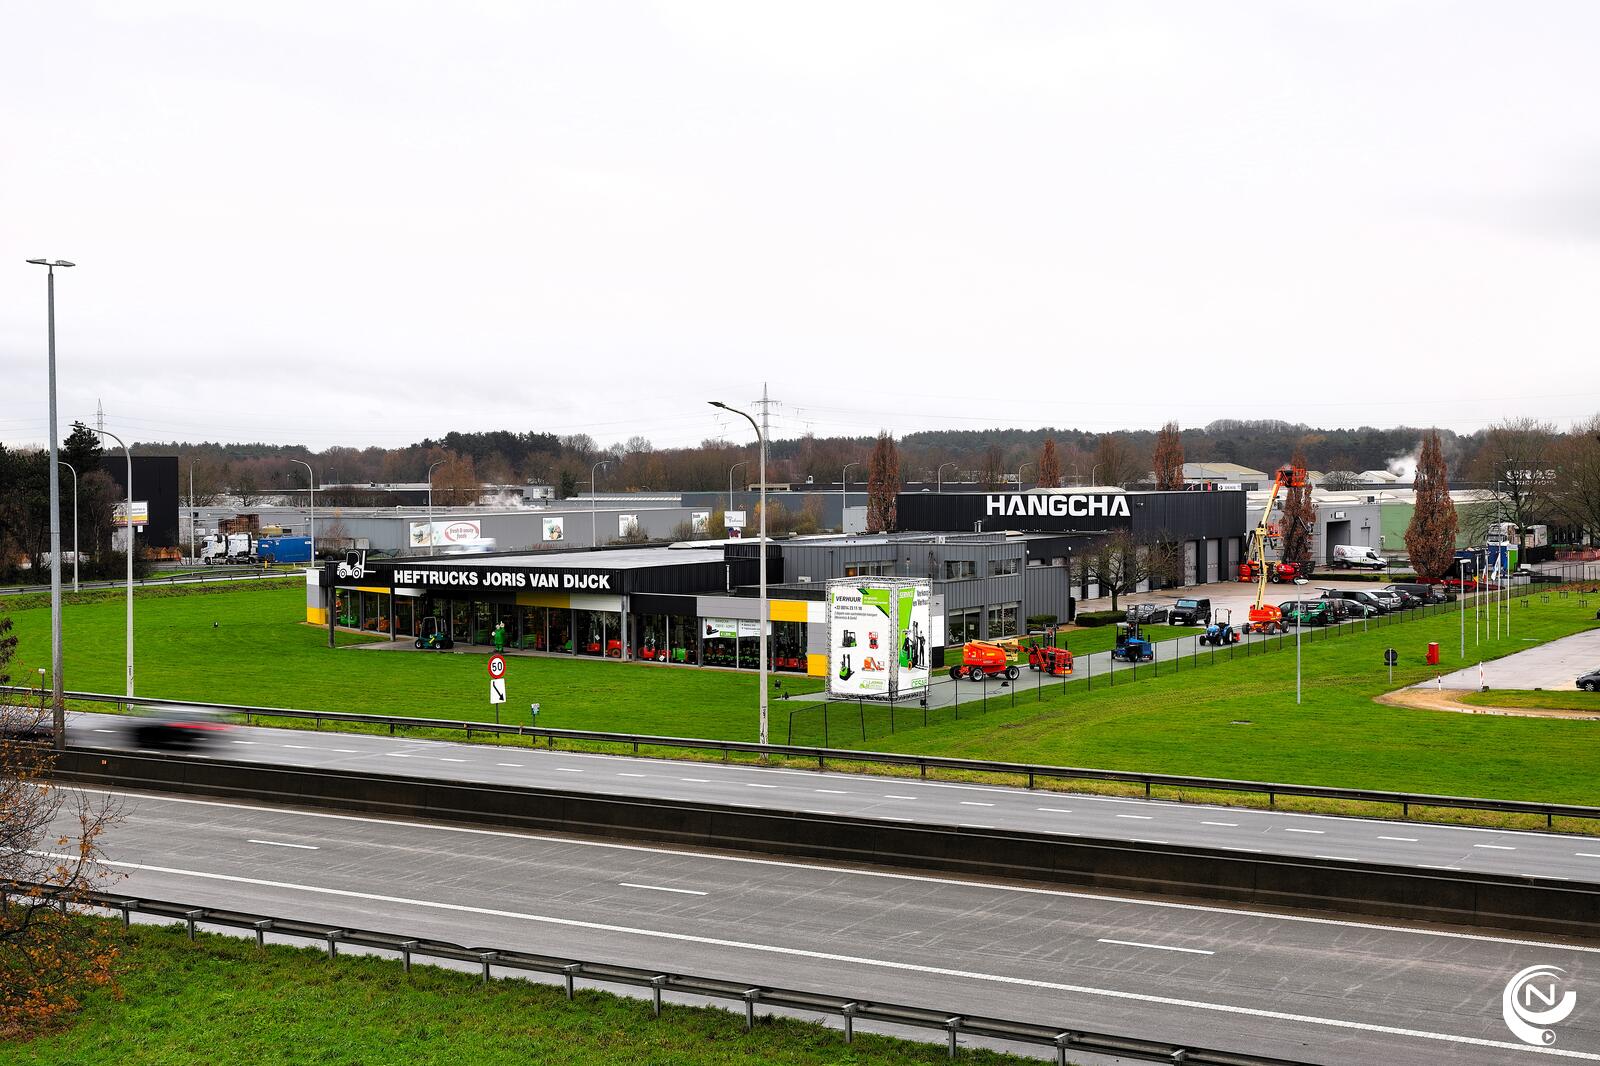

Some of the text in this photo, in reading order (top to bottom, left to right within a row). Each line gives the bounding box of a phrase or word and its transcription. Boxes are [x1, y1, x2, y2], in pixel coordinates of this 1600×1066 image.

[986, 495, 1131, 517] HANGCHA
[394, 570, 611, 590] HEFTRUCKS JORIS VAN DIJCK
[835, 595, 862, 603] VERHUUR
[492, 661, 503, 672] 50
